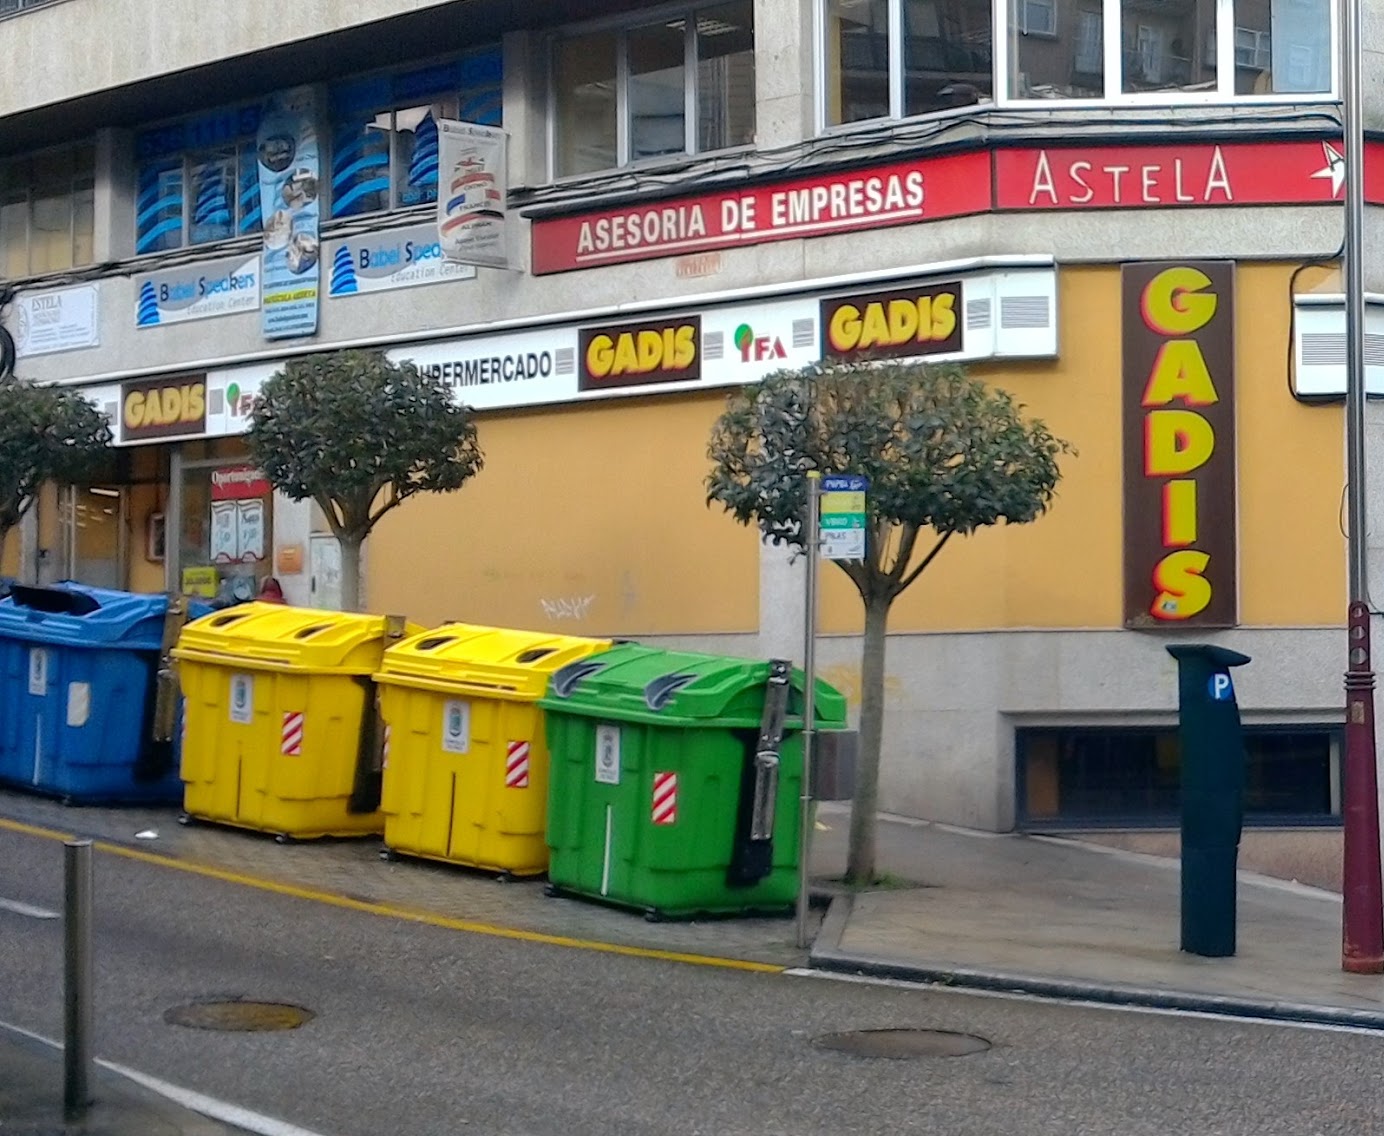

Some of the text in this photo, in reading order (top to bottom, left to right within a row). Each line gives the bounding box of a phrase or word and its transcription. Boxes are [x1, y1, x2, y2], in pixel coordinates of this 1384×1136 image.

[1029, 145, 1234, 206] ASTELA
[577, 170, 925, 254] ASESORIA DE EMPRESAS
[359, 246, 400, 269] Babel
[199, 272, 255, 299] Speakers
[828, 291, 957, 352] GADIS
[585, 324, 696, 379] GADIS
[124, 382, 206, 430] GADIS
[1140, 265, 1220, 622] GADIS
[1213, 672, 1230, 699] P
